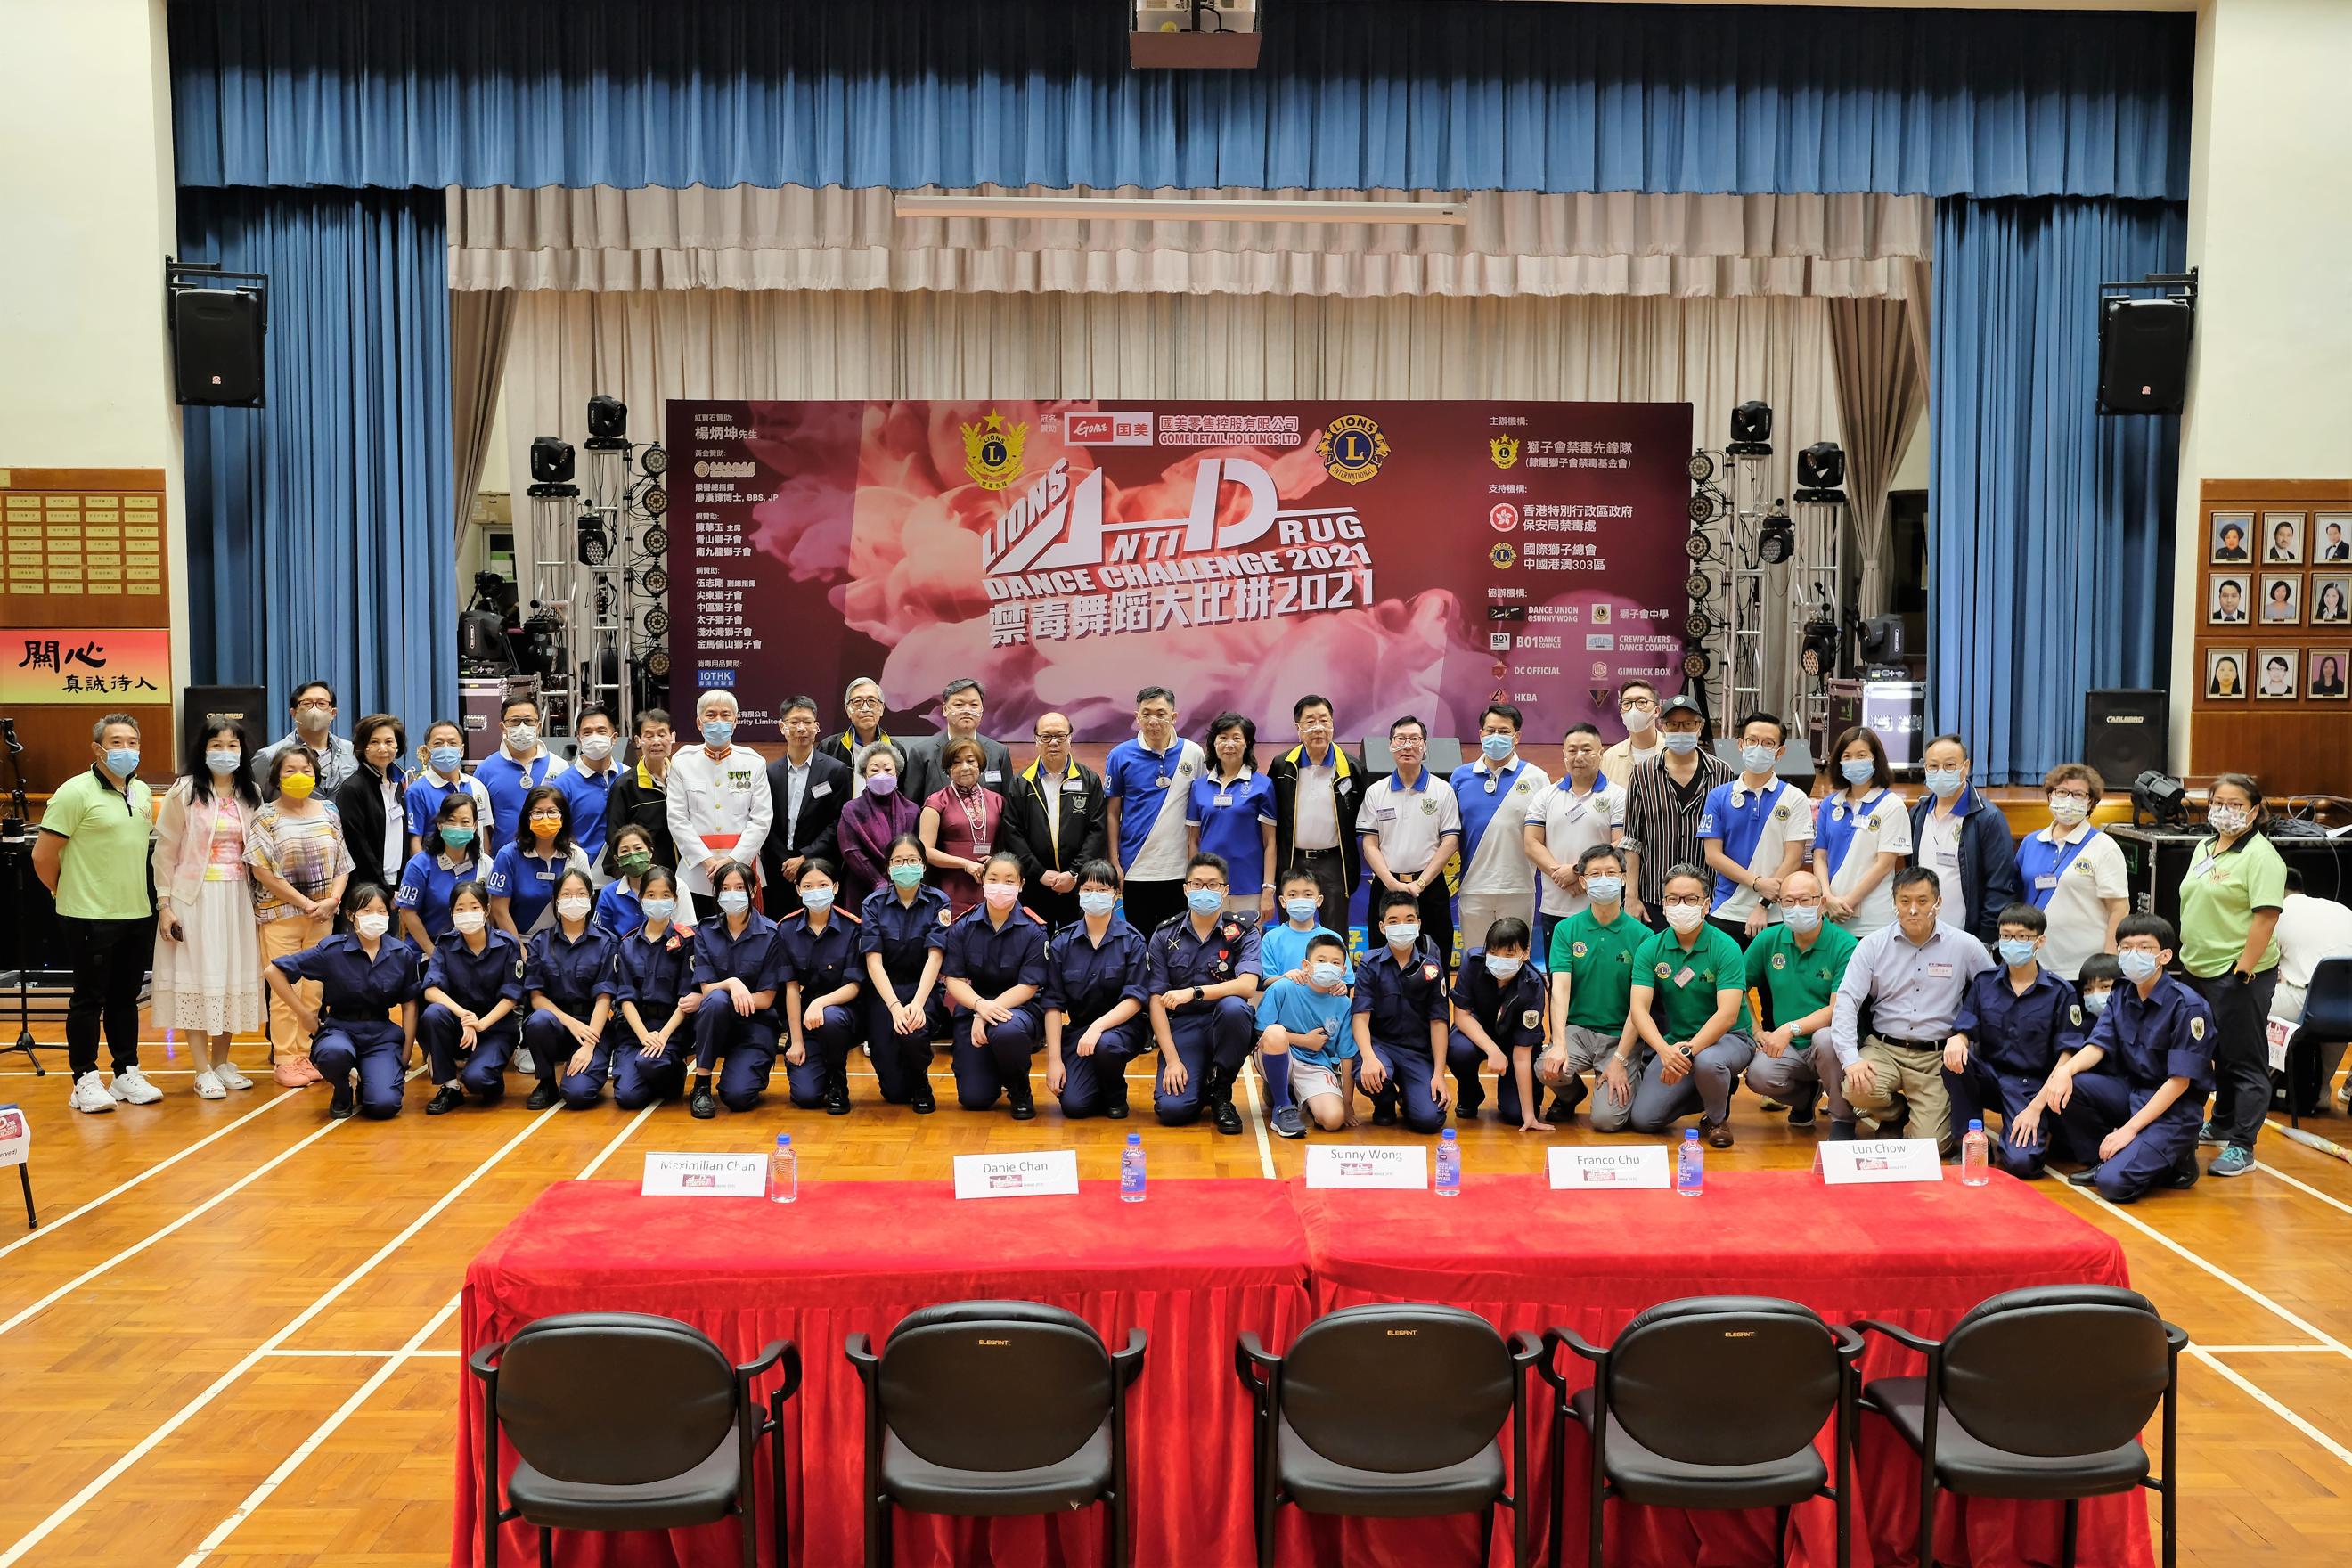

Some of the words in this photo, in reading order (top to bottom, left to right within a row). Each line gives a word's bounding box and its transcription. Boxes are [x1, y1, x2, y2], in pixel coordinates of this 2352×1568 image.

[1116, 423, 1148, 436] 国美
[1161, 416, 1298, 431] 國美零售控股有限公司
[1333, 416, 1375, 432] LIONS
[983, 435, 1006, 445] LIONS
[1161, 433, 1191, 445] GOME
[1193, 433, 1225, 445] RETAIL
[1228, 433, 1279, 445] HOLDINGS
[1282, 433, 1300, 445] LTD
[1345, 436, 1364, 461] L
[1527, 441, 1632, 454] 獅子會禁毒先鋒隊
[1333, 467, 1375, 480] INTERNATIONAL
[1489, 484, 1527, 494] 支持機構:
[982, 457, 1067, 570] LIONS
[1523, 504, 1633, 518] 香港特別行政區政府
[1523, 519, 1597, 533] 保安局禁毒處
[1523, 543, 1597, 556] 國際獅子總會
[1523, 558, 1605, 571] 中國港澳303區
[983, 568, 1097, 600] DANCE
[1098, 551, 1284, 588] CHALLENGE
[1285, 543, 1372, 571] 2021
[1528, 606, 1553, 614] DANCE
[1555, 606, 1579, 614] UNION
[1620, 609, 1669, 619] 獅子會中學
[1619, 635, 1670, 643] CREWPLAYERS
[700, 672, 731, 680] IOTHK
[1514, 667, 1525, 675] DC
[1526, 667, 1561, 675] OFFICIAL
[1617, 667, 1653, 675] GIMMICK
[1654, 668, 1670, 676] BOX
[1515, 693, 1538, 701] HKBA
[1852, 1145, 1872, 1155] Lun
[1875, 1143, 1906, 1154] Chow
[1331, 1149, 1366, 1161] Sunny
[1368, 1149, 1403, 1162] Wong
[1577, 1156, 1615, 1165] Franco
[1618, 1155, 1640, 1164] Chu
[983, 1163, 1017, 1173] Danie
[1019, 1161, 1049, 1172] Chan
